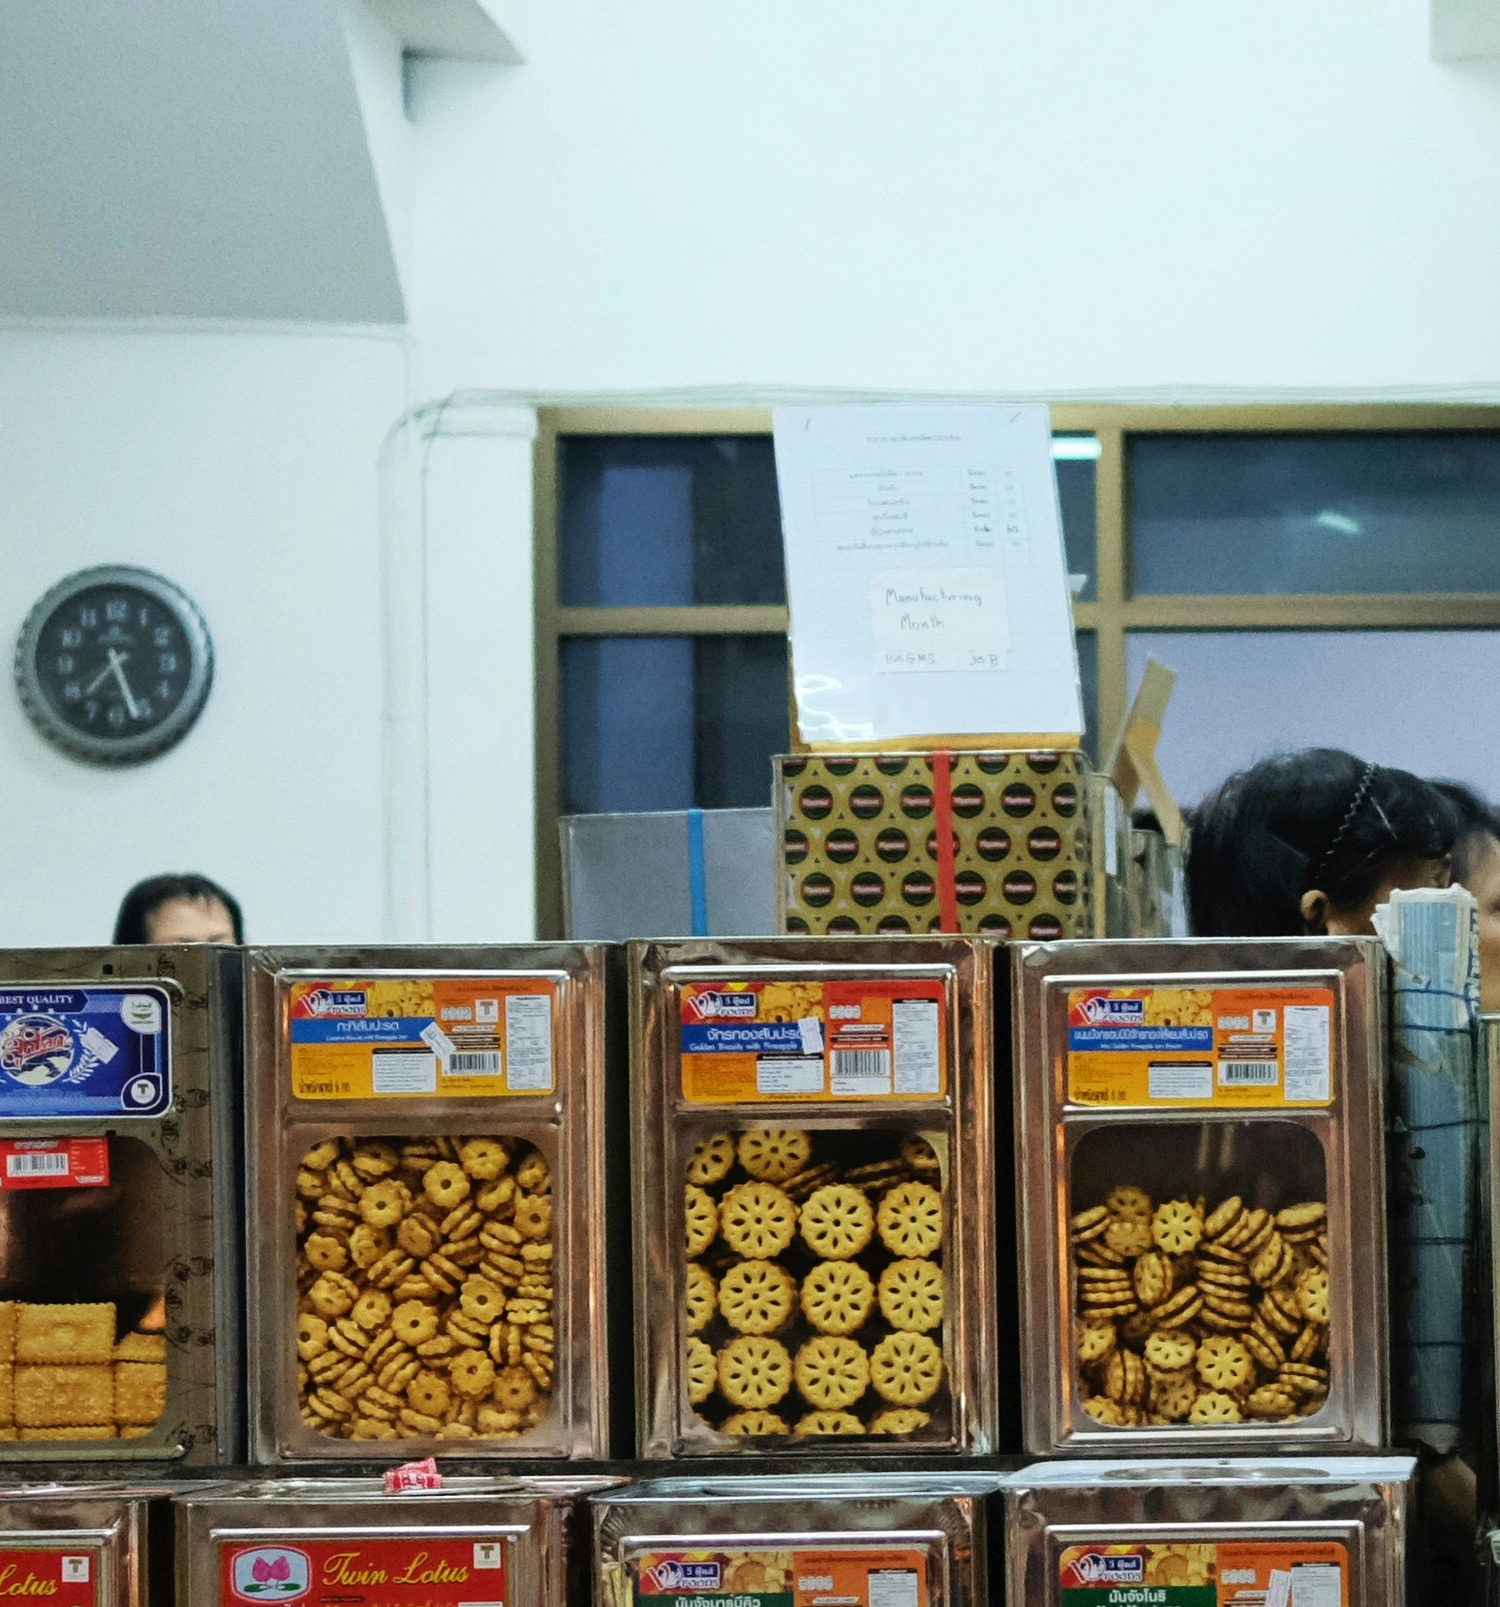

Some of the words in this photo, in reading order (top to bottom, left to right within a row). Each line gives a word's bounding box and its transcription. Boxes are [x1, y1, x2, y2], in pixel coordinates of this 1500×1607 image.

[26, 993, 74, 1006] QUALITY
[322, 1551, 388, 1586] Twin
[393, 1551, 469, 1585] Lotus
[1108, 1588, 1167, 1604] มันจังโนริ
